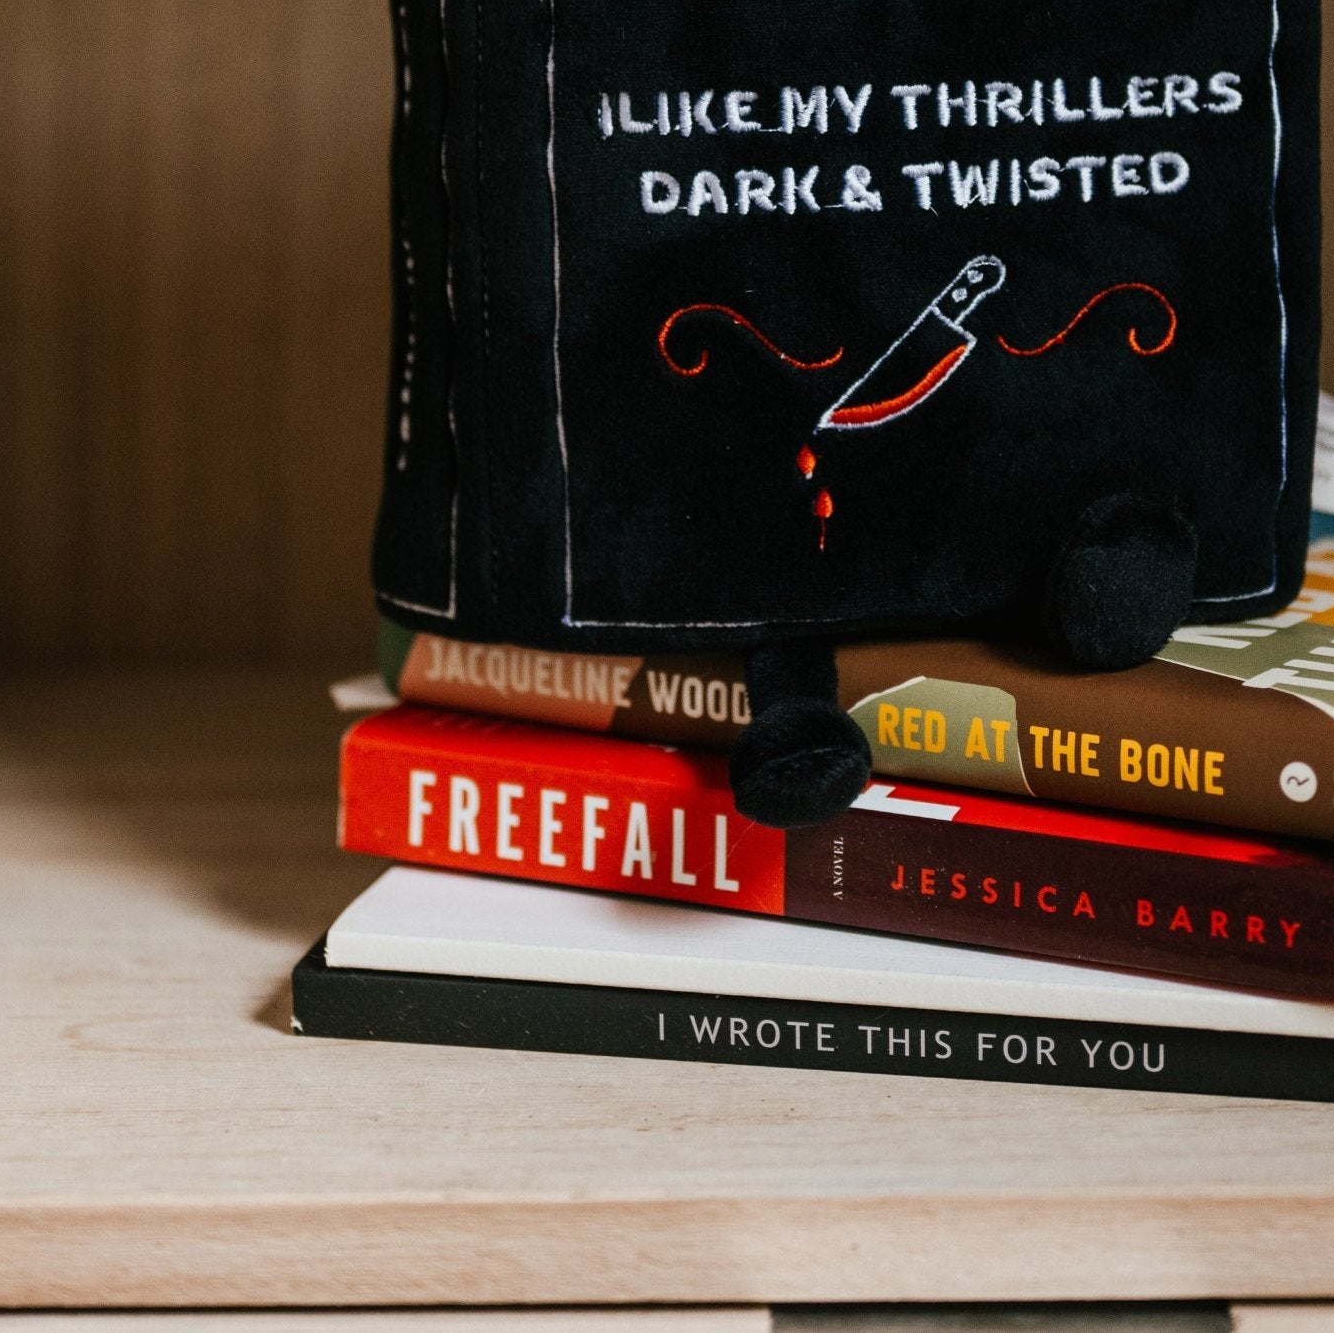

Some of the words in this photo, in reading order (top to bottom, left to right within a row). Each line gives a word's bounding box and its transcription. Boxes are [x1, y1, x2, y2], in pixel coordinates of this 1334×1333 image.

[779, 83, 872, 134] MY
[890, 71, 1243, 130] THRILLERS
[640, 165, 822, 216] DARK
[841, 165, 882, 212] &
[901, 151, 1190, 209] TWISTED
[424, 640, 632, 709] JACQUELINE
[646, 670, 753, 726] WOOD
[877, 702, 946, 754] RED
[965, 717, 1011, 763] AT
[1029, 725, 1099, 778] THE
[1119, 738, 1226, 796] BONE
[408, 769, 740, 893] FREEFALL
[833, 836, 845, 886] NOVEL
[890, 865, 1097, 920] JESSICA
[1137, 900, 1302, 949] BARRY
[657, 1013, 665, 1041] I
[690, 1014, 836, 1053] WROTE
[858, 1026, 953, 1059] THIS
[978, 1033, 1058, 1068] FOR
[1080, 1039, 1166, 1074] YOU
